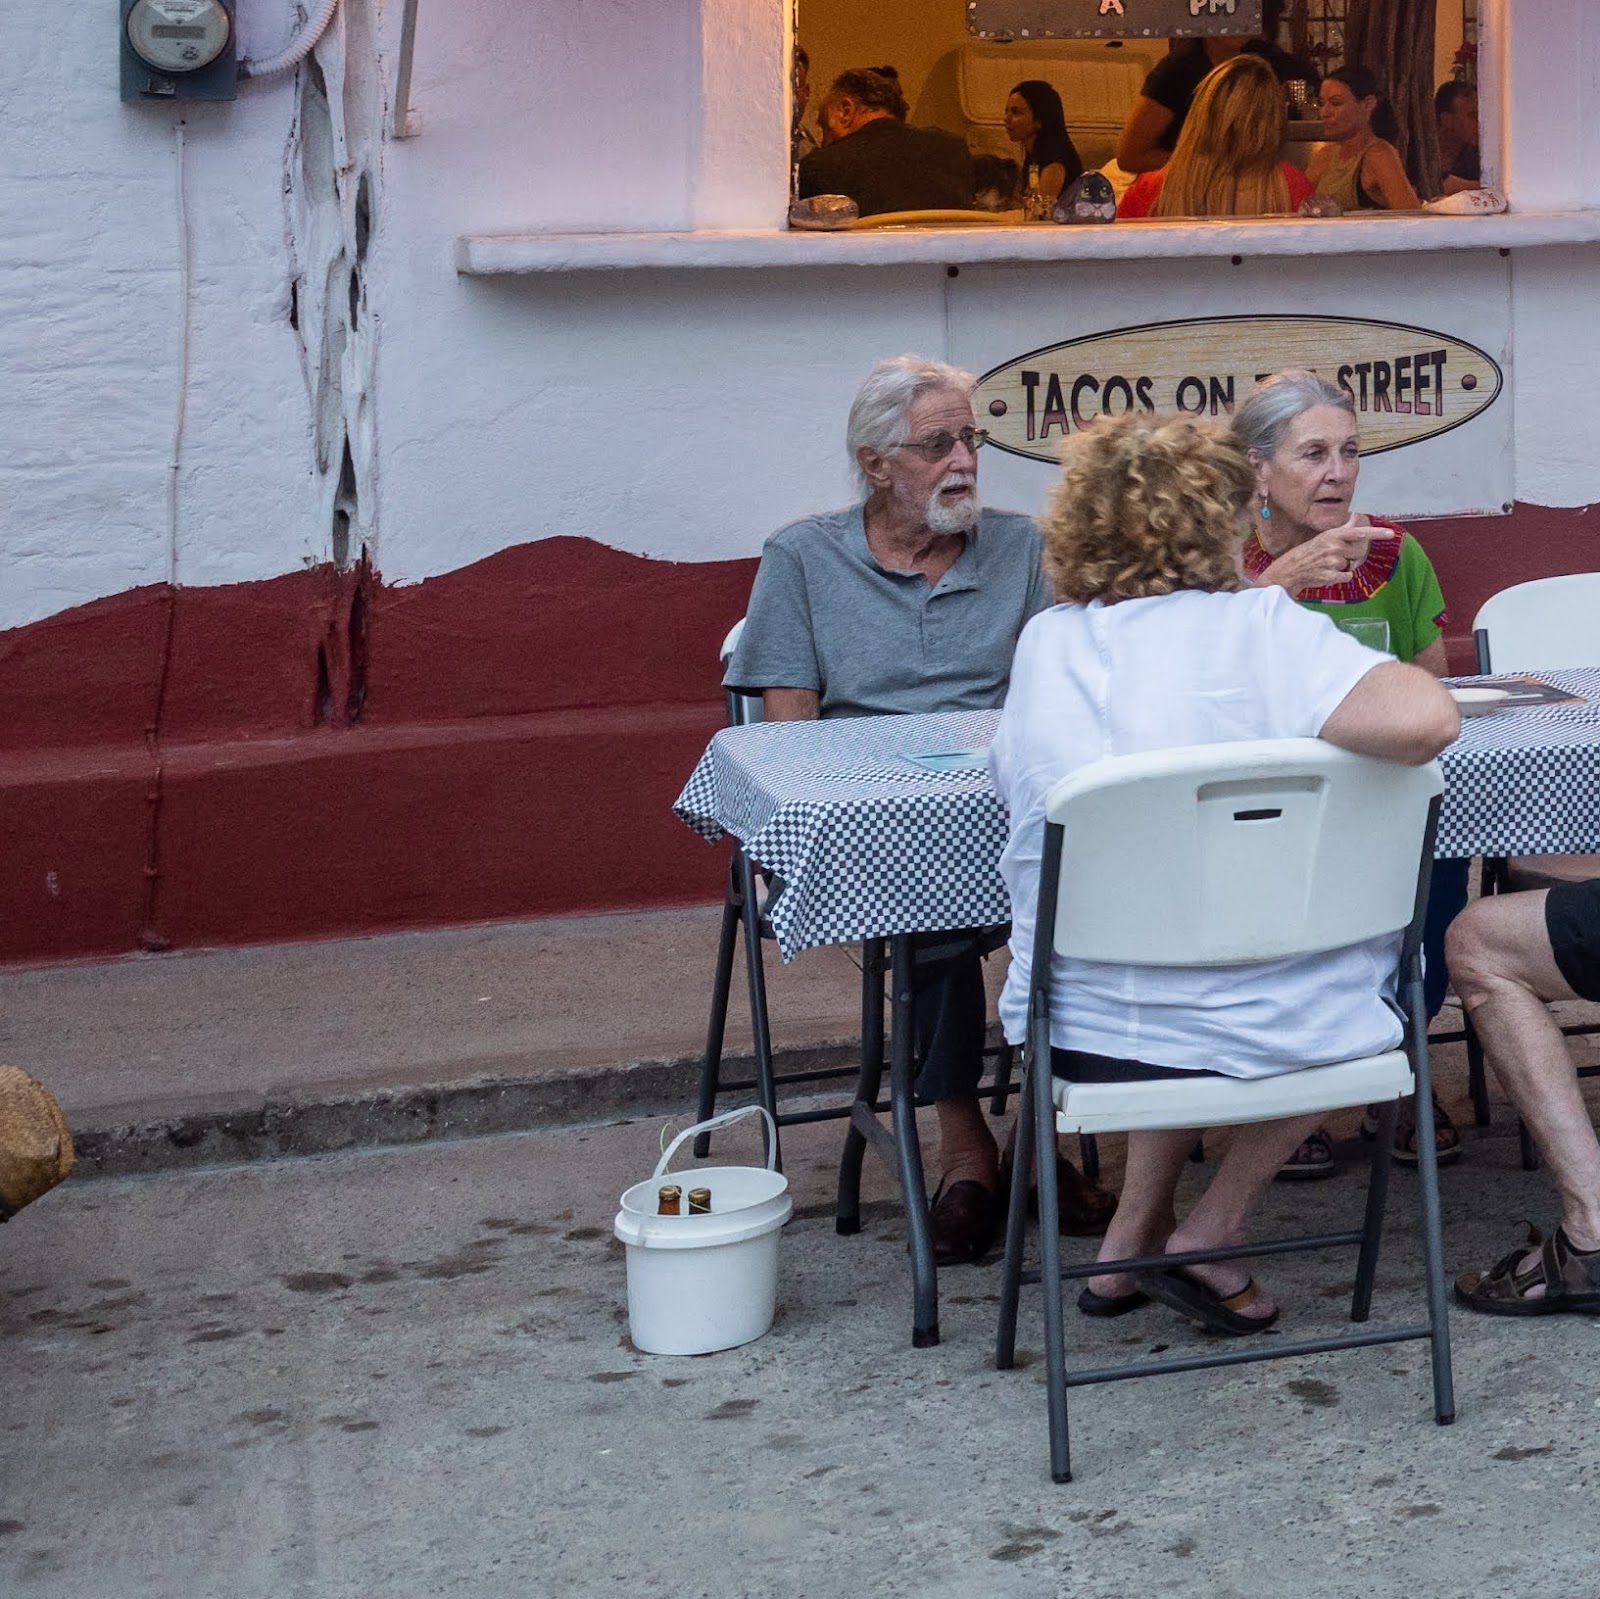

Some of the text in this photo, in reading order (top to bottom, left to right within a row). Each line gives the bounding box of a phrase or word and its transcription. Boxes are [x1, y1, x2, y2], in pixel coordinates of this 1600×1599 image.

[1021, 349, 1448, 442] TACOS ON STREET
